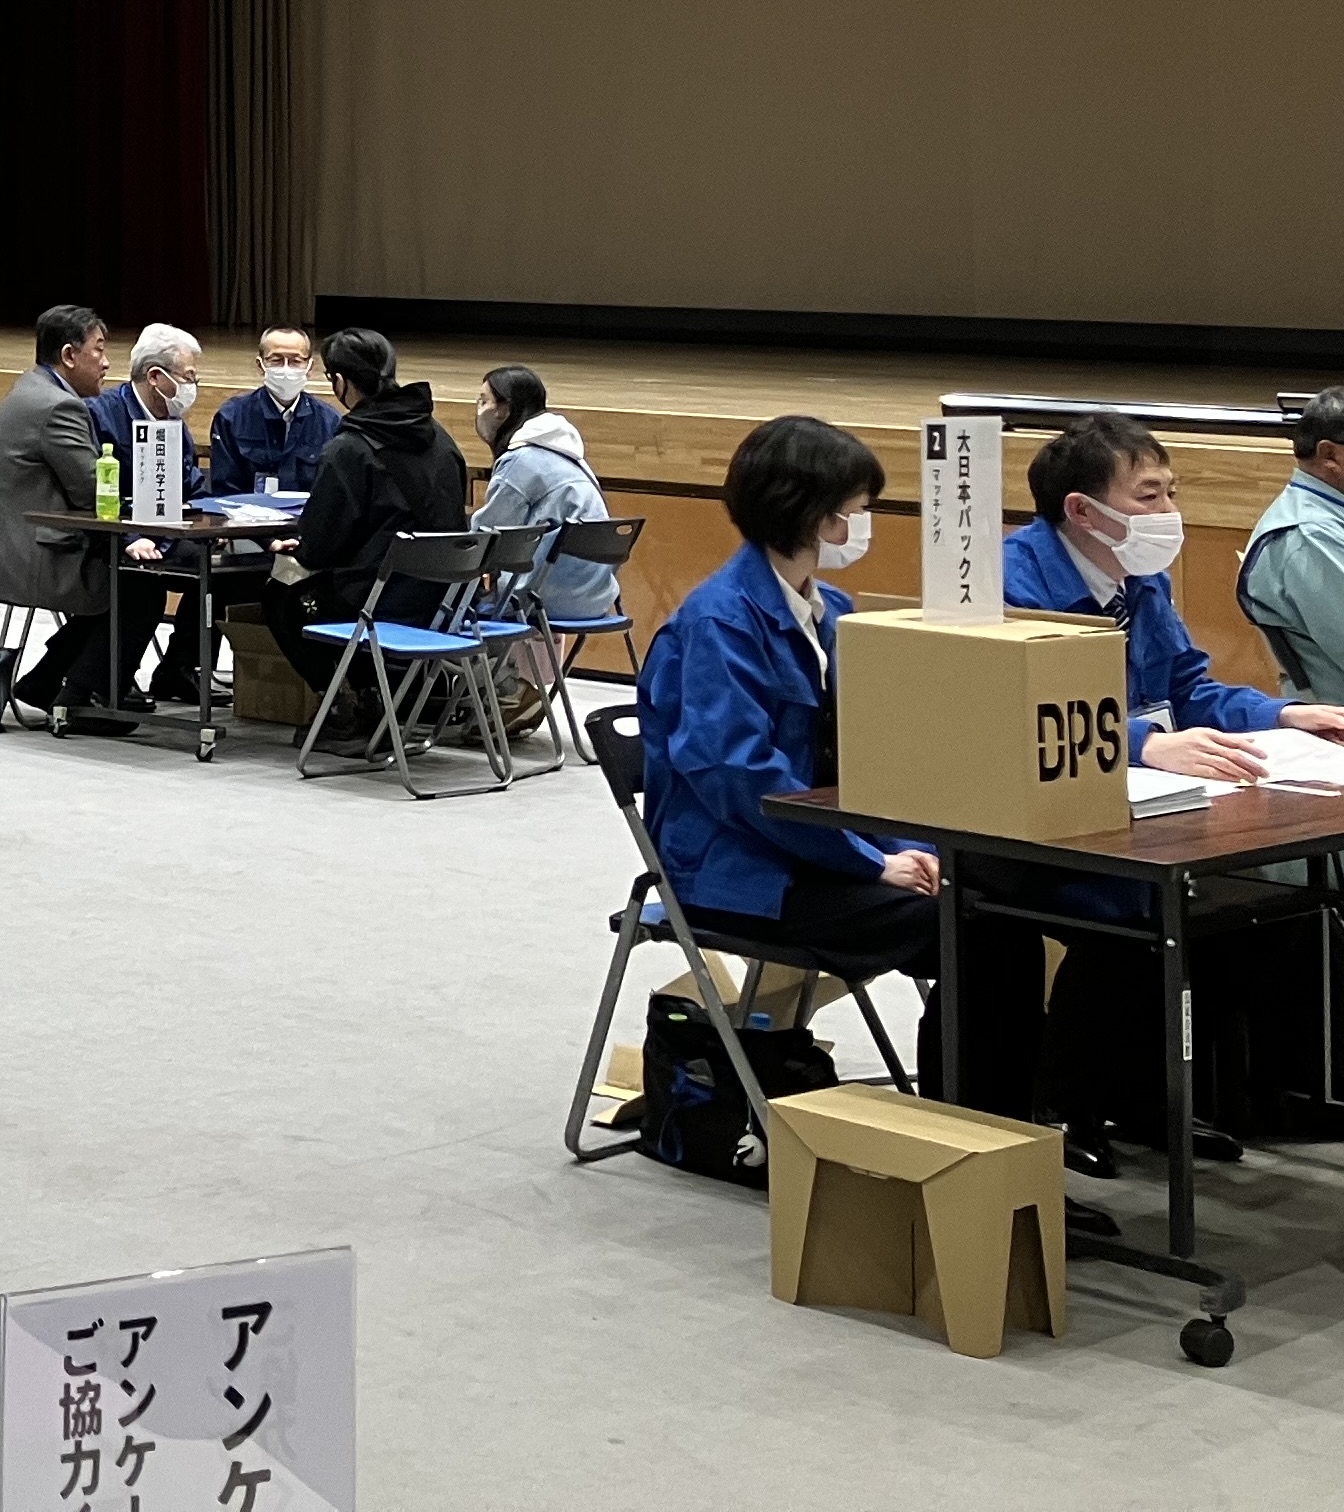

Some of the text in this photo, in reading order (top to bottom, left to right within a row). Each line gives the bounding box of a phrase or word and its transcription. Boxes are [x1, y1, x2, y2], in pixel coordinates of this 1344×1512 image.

[932, 431, 941, 451] 2
[932, 468, 942, 544] マッチング
[956, 429, 972, 604] 大日本パックス
[1037, 696, 1122, 782] DPS
[59, 1318, 105, 1512] ご協力
